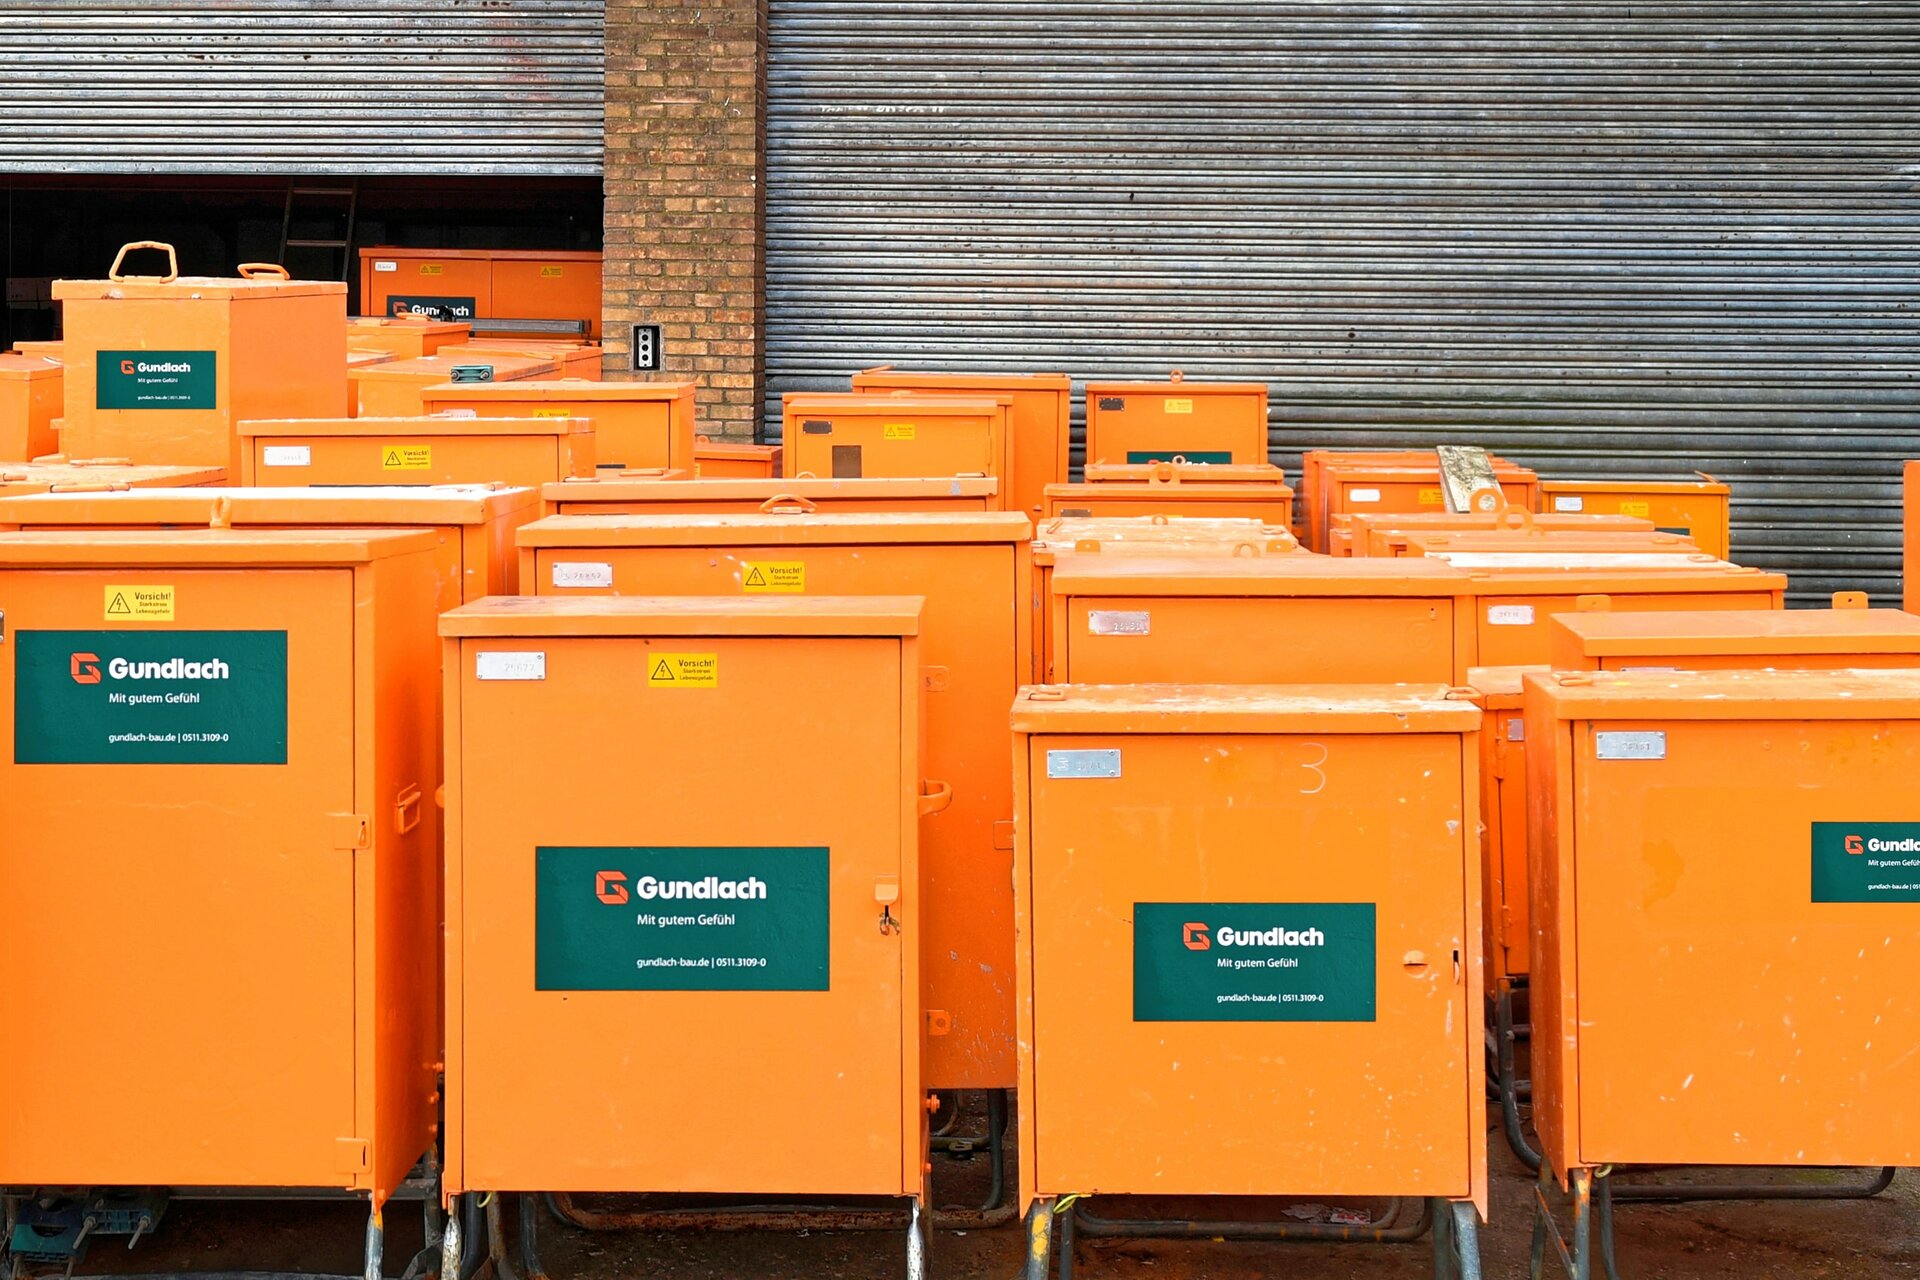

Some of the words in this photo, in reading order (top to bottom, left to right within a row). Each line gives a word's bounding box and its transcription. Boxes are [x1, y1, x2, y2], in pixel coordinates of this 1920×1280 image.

[411, 305, 469, 317] Gunch
[138, 361, 191, 374] Gundlach
[134, 592, 172, 600] Vorsicht!
[108, 657, 230, 681] Gundlach
[678, 659, 715, 667] Vorsicht!
[108, 692, 127, 704] Mit
[128, 694, 163, 706] gutem
[164, 692, 200, 704] Gefühl
[108, 732, 177, 744] gundlach-bau.de
[181, 733, 229, 742] 0511.3109-0
[1299, 742, 1328, 794] 3
[637, 874, 767, 900] Gundlach
[637, 914, 656, 926] Mit
[657, 916, 696, 928] gutem
[697, 913, 736, 926] Gefühl
[1217, 926, 1325, 947] Gundlach
[637, 957, 710, 969] gundlach-bau.de
[716, 958, 767, 967] 0511.3109-0
[1217, 957, 1233, 968] Mit
[1234, 959, 1266, 970] gutem
[1267, 957, 1299, 968] Gefühl
[1217, 993, 1278, 1004] gundlach-bau.de
[1283, 994, 1325, 1003] 0511.3109-0
